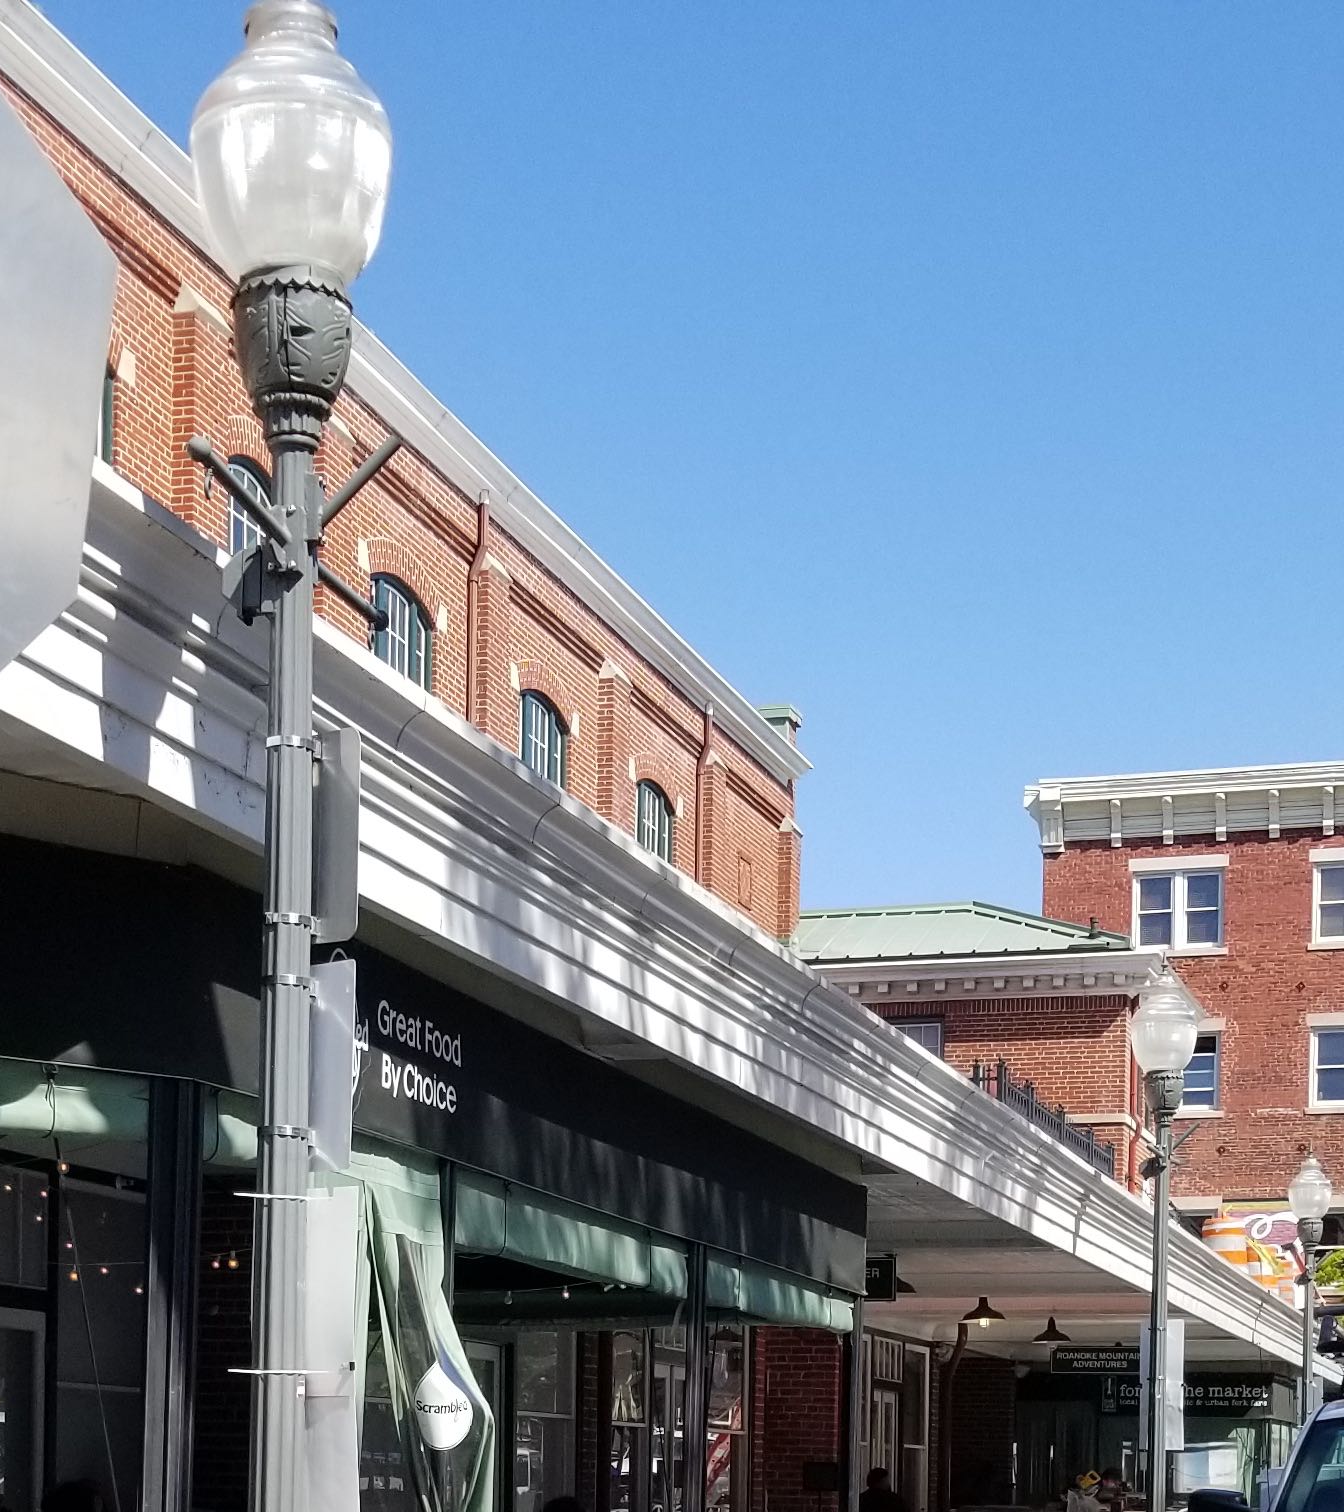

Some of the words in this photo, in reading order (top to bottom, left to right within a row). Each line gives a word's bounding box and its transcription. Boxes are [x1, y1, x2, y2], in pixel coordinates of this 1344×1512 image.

[377, 1000, 422, 1050] Great
[425, 1020, 462, 1067] Food
[381, 1053, 402, 1098] By
[403, 1063, 457, 1114] Choice
[1056, 1352, 1098, 1360] ROANOKE
[1072, 1360, 1128, 1368] ADVENTURES
[1184, 1385, 1204, 1398] he
[1208, 1384, 1268, 1398] market
